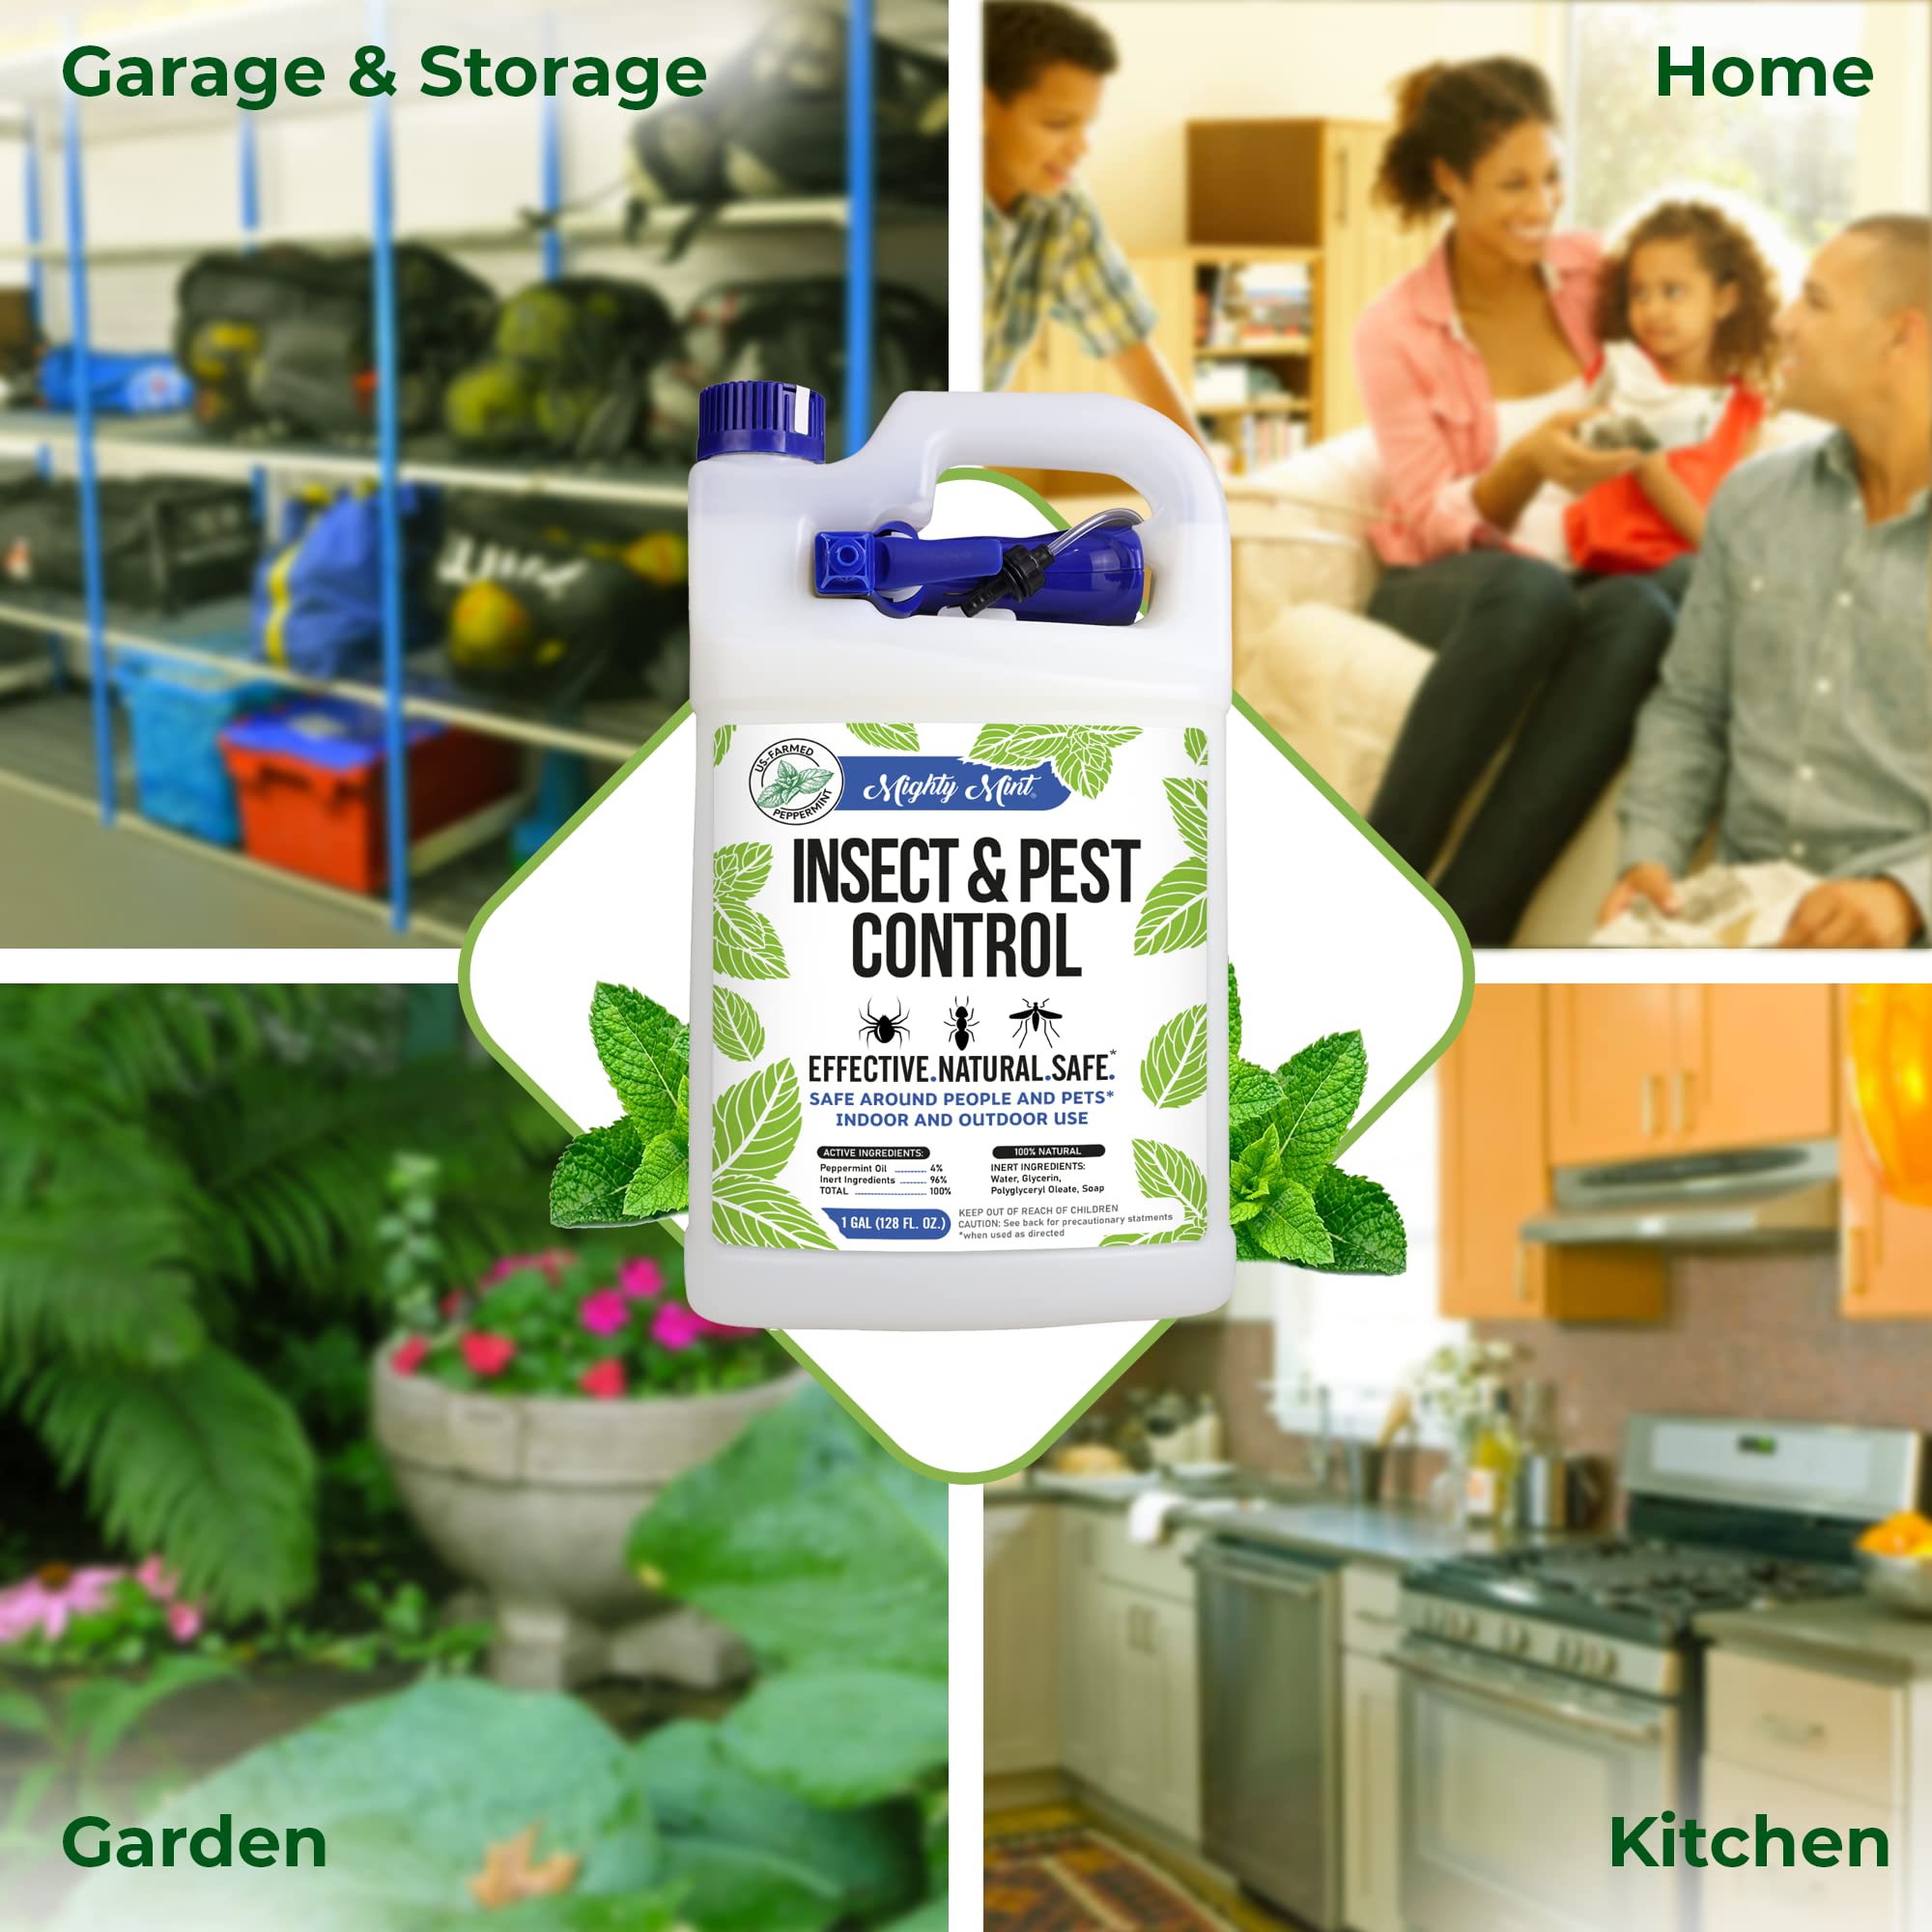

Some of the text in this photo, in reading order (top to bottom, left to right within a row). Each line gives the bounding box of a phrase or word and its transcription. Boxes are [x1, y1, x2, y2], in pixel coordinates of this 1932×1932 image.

[754, 744, 814, 774] US-FARMED
[863, 773, 959, 808] Mighty
[773, 788, 833, 820] PEPPERMINT
[793, 837, 1142, 904] INSECT & PEST
[852, 911, 1083, 979] CONTROL
[810, 1092, 855, 1106] SAFE
[860, 1093, 938, 1106] AROUND
[944, 1093, 1012, 1106] PEOPLE
[1016, 1091, 1056, 1105] AND
[836, 1111, 1089, 1127] INDOOR AND OUTDOOR USE
[823, 1149, 923, 1157] ACTIVE INGREDIENTS:
[1014, 1147, 1082, 1156] 100% NATURAL
[820, 1163, 943, 1174] Peppermint Oil 4%
[991, 1162, 1086, 1172] INERT INGREDIENTS:
[820, 1175, 948, 1186] Inert Ingredients 96%
[990, 1174, 1062, 1184] Water, Glycerin,
[819, 1186, 952, 1196] TOTAL 100%
[991, 1184, 1105, 1197] Polyglyceryl Oleate, Soap
[958, 1208, 983, 1217] KEEP
[986, 1208, 1005, 1216] OUT
[1007, 1208, 1019, 1216] OF
[1021, 1207, 1053, 1215] REACH
[1070, 1205, 1119, 1214] CHILDREN
[841, 1216, 947, 1231] 1 GAL (128 FL. OZ.)
[958, 1213, 1173, 1228] CAUTION: See back for precautionary statments
[990, 1230, 1012, 1238] used
[1028, 1229, 1065, 1238] directed
